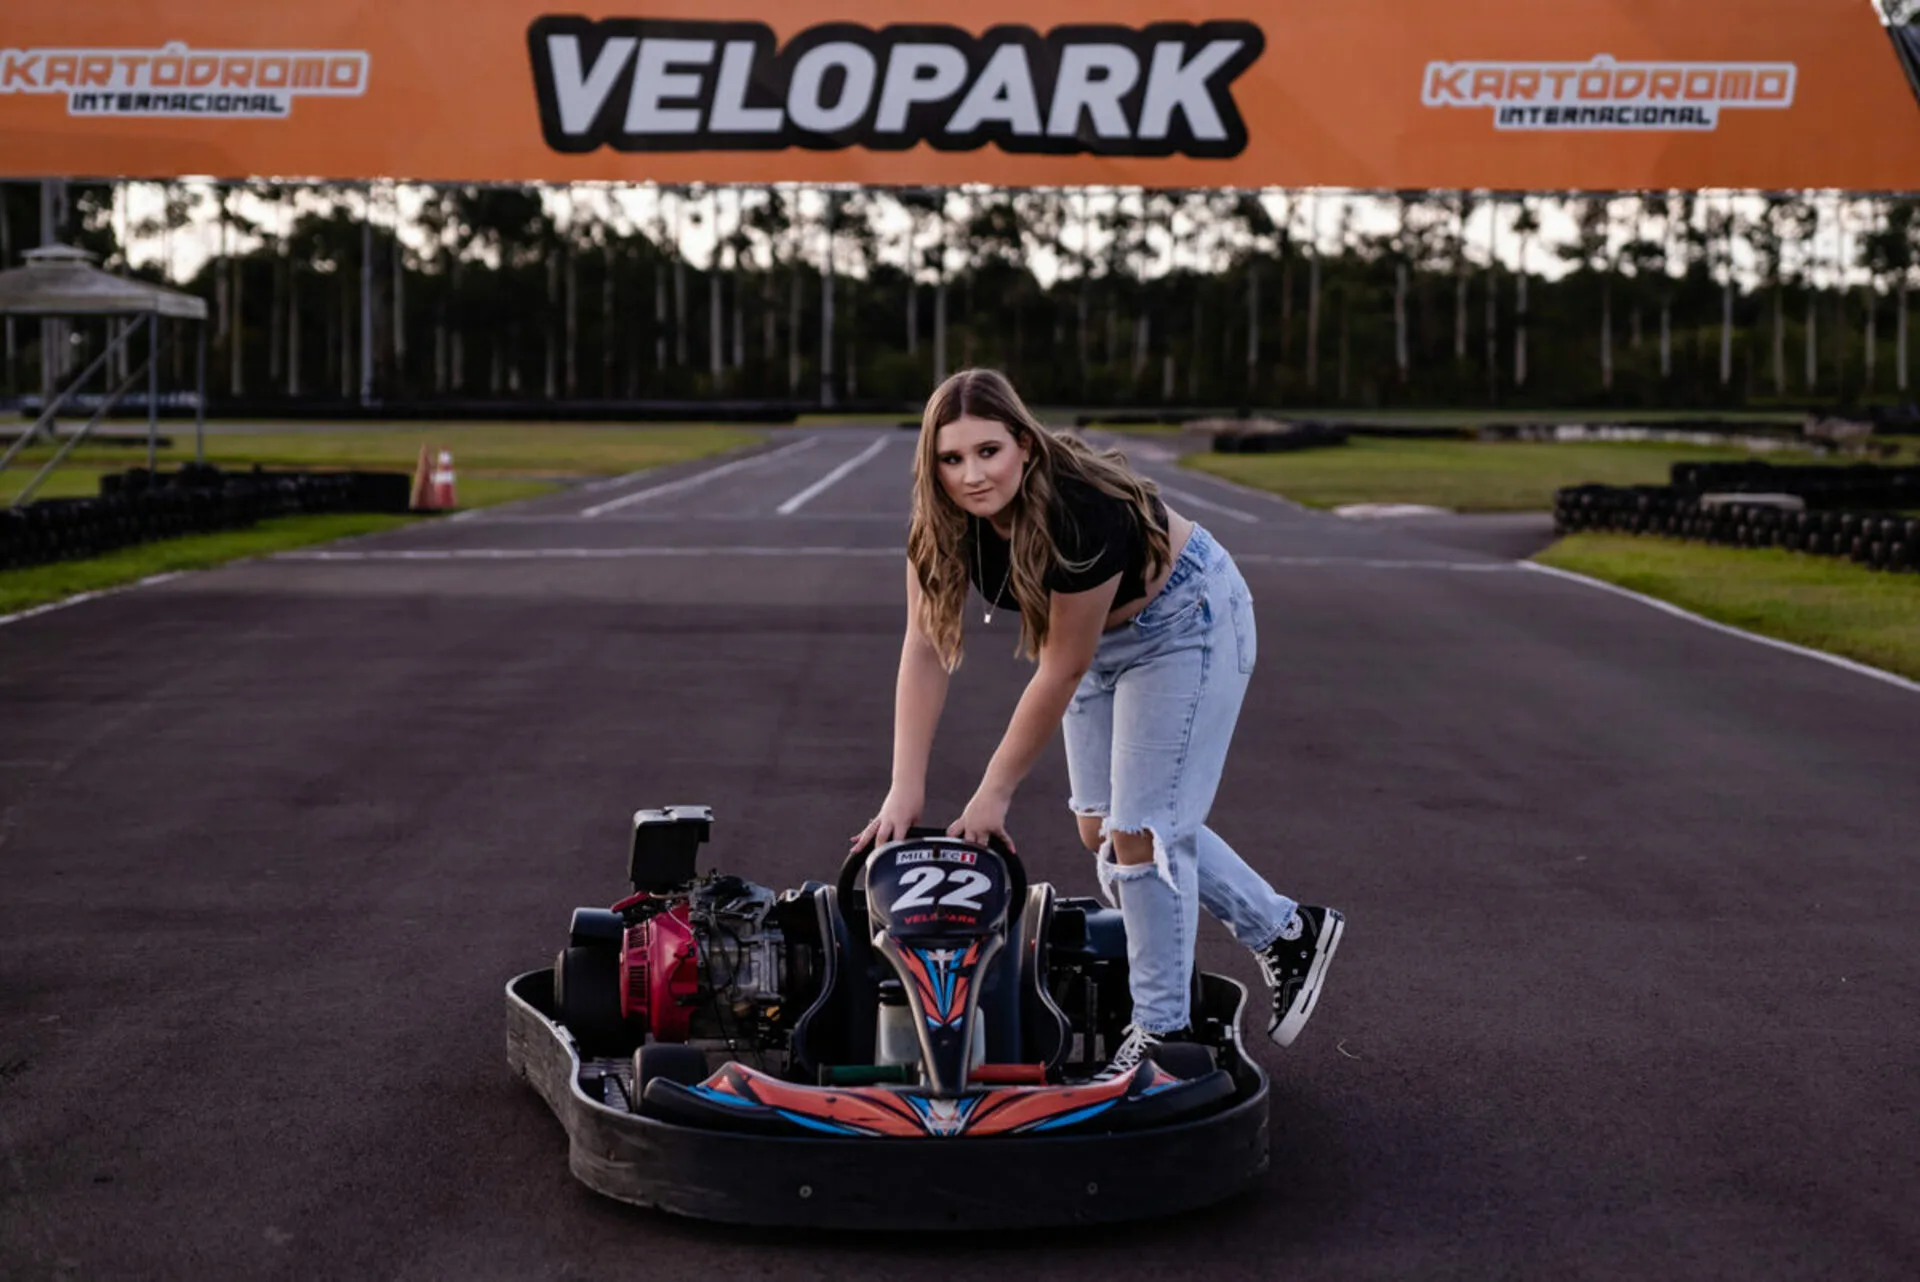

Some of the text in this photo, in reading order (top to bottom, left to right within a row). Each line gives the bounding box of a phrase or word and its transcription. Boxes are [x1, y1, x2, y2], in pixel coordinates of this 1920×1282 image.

[2, 47, 363, 88] KARTÓDROMO
[547, 34, 1245, 140] VELOPARK
[1429, 60, 1789, 101] KARTÓDROMO
[72, 92, 284, 113] INTERNACIONAL
[1500, 105, 1712, 125] INTERNACIONAL
[890, 866, 992, 912] 22
[904, 913, 976, 925] VELOARK
